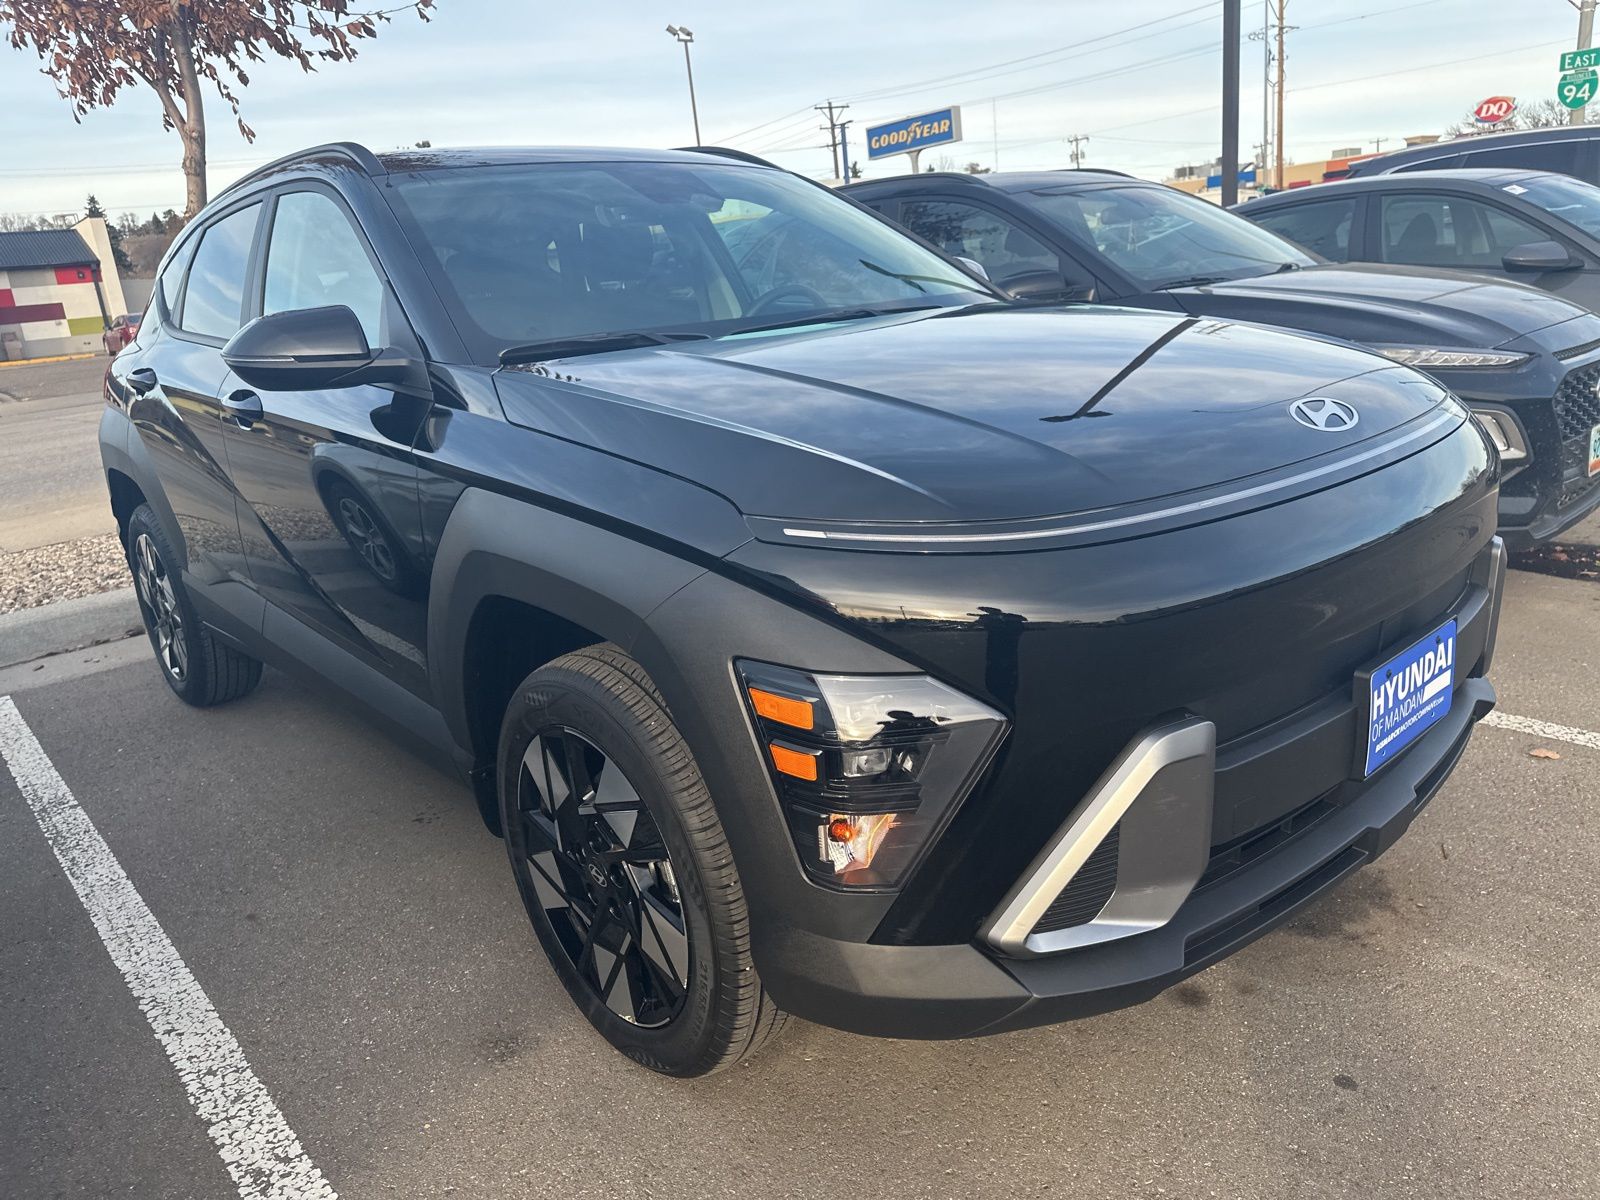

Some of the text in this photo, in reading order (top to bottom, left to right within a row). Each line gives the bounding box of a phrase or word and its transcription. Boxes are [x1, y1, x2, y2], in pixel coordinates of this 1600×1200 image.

[1565, 53, 1596, 69] EAST
[1563, 83, 1590, 103] 94
[1480, 101, 1507, 117] DQ
[1372, 637, 1453, 721] HYUNDAI
[1371, 690, 1425, 742] OF MANDAN
